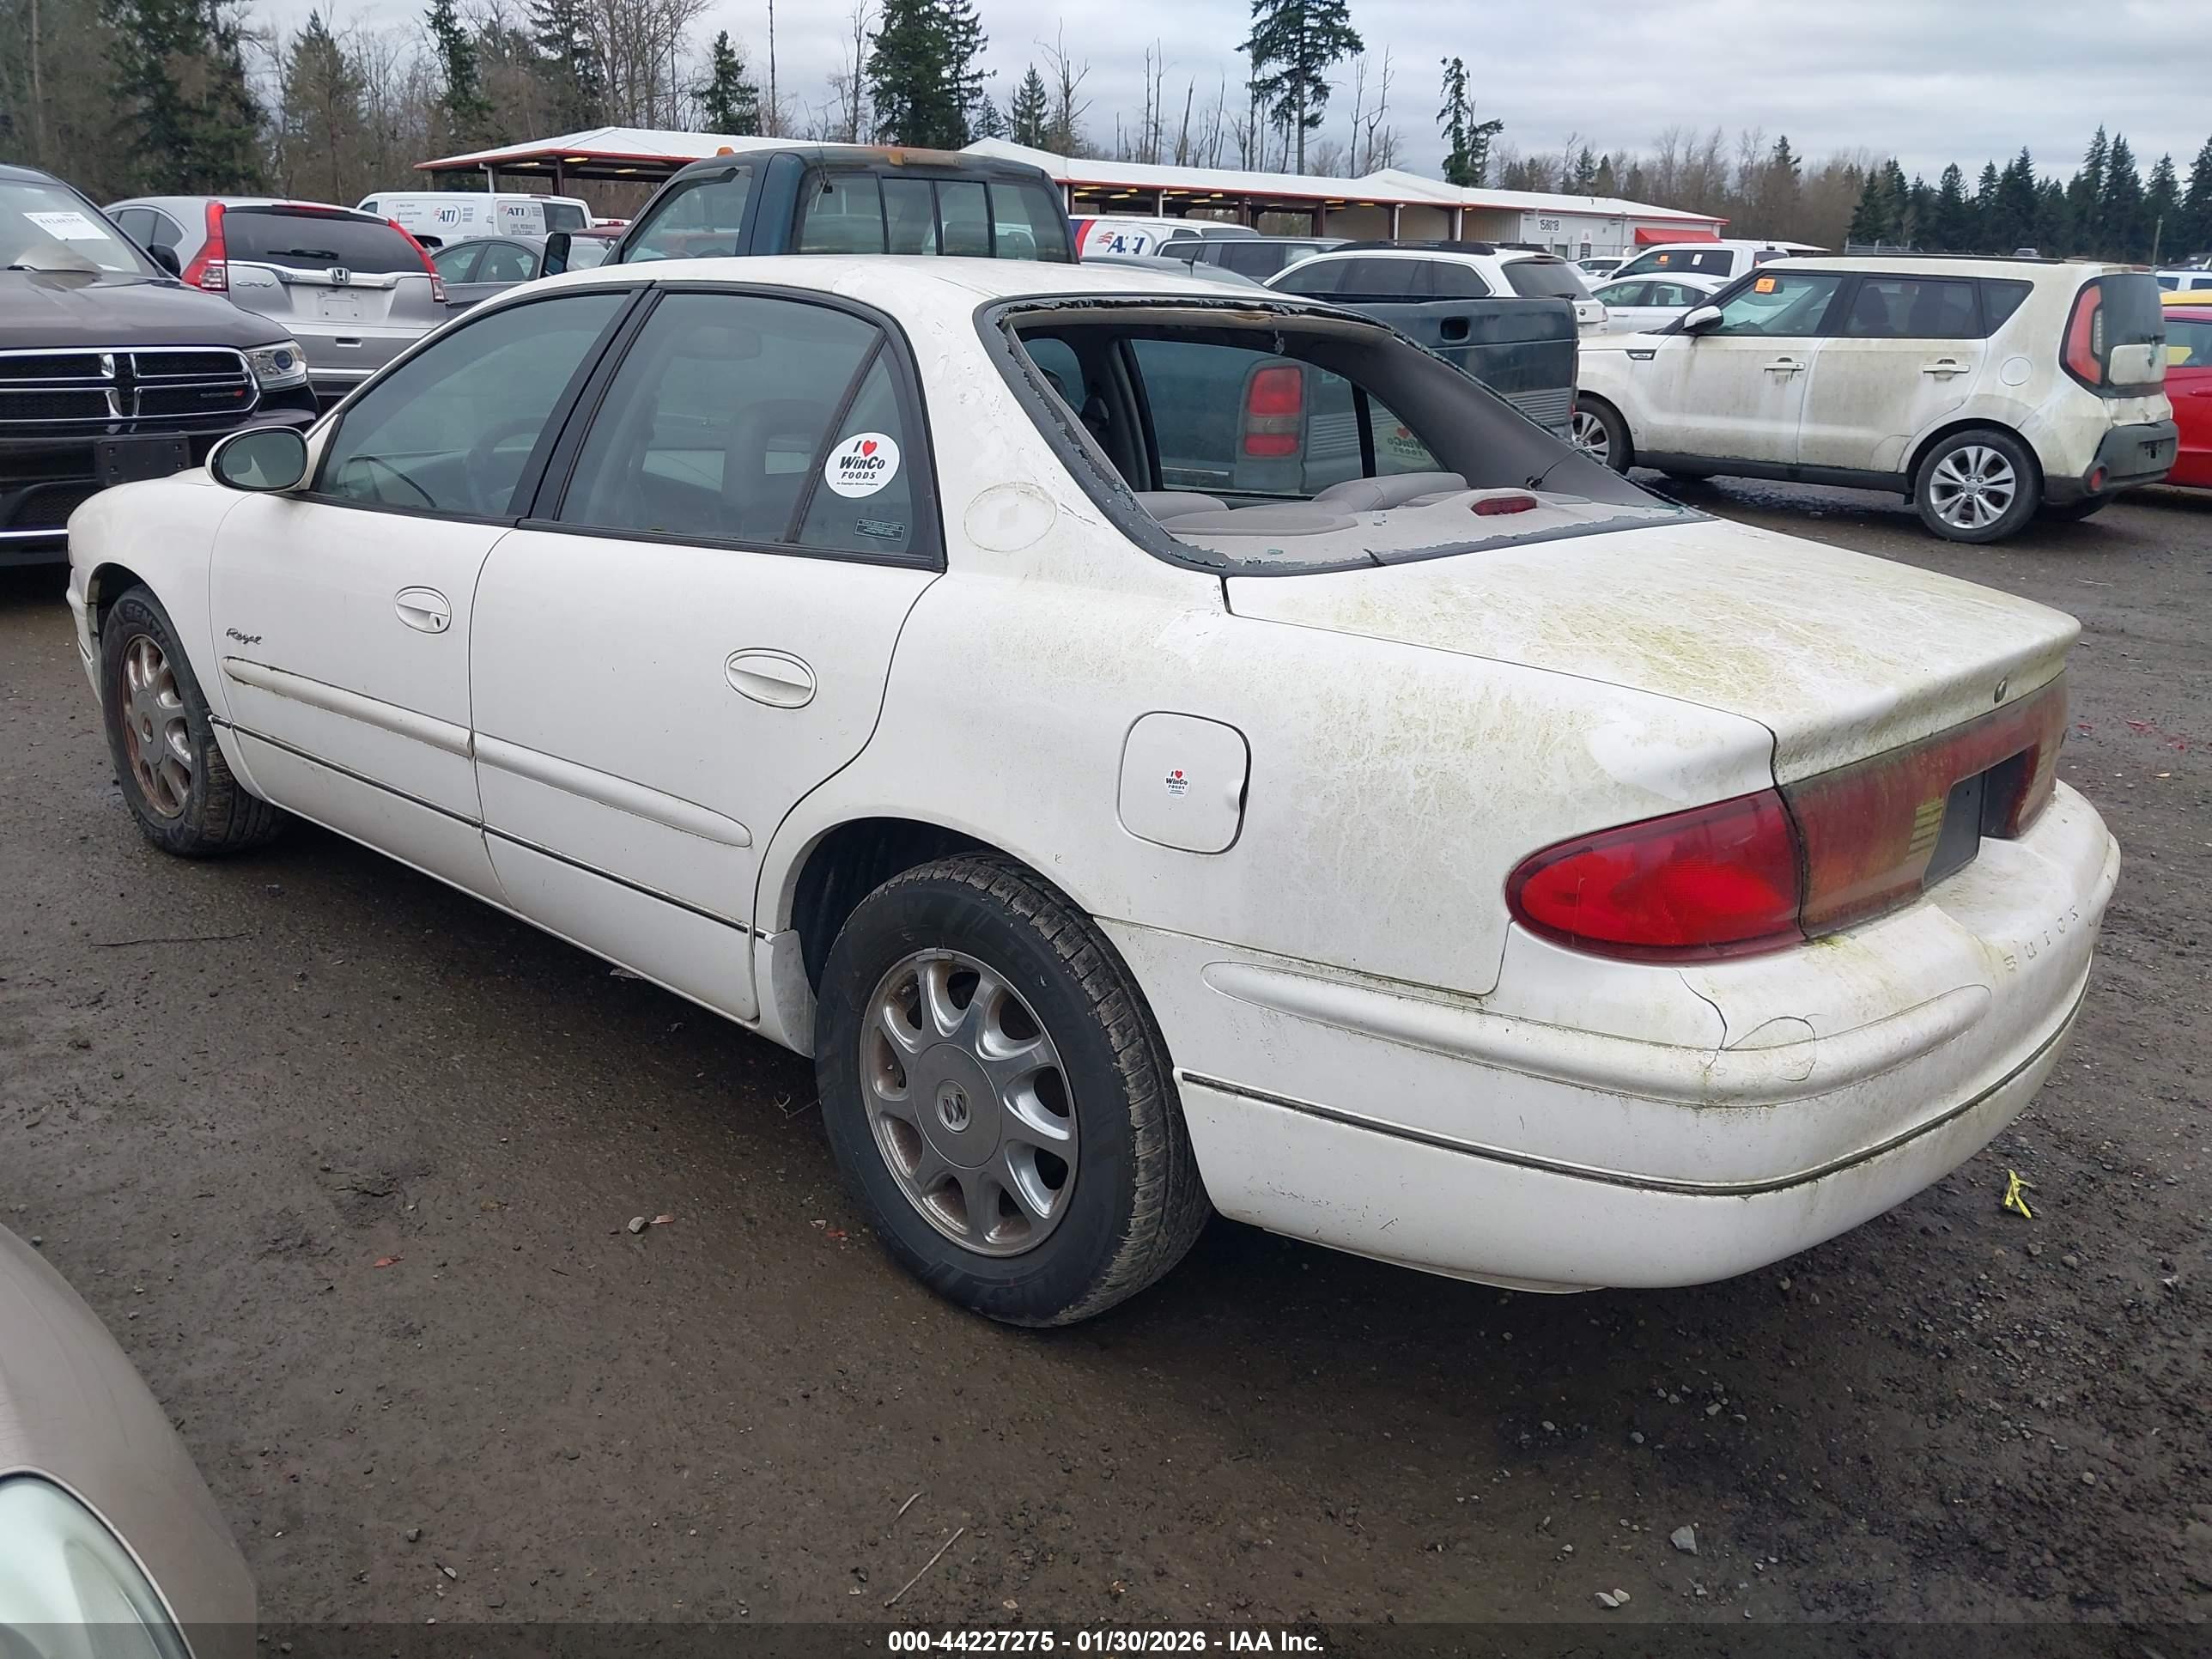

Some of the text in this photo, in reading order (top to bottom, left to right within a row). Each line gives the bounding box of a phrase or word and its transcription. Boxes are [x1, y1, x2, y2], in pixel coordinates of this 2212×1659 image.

[438, 210, 456, 222] ATI
[507, 207, 525, 216] ATI
[854, 441, 862, 453] I
[839, 455, 885, 470] WinCo
[226, 627, 262, 645] Regal
